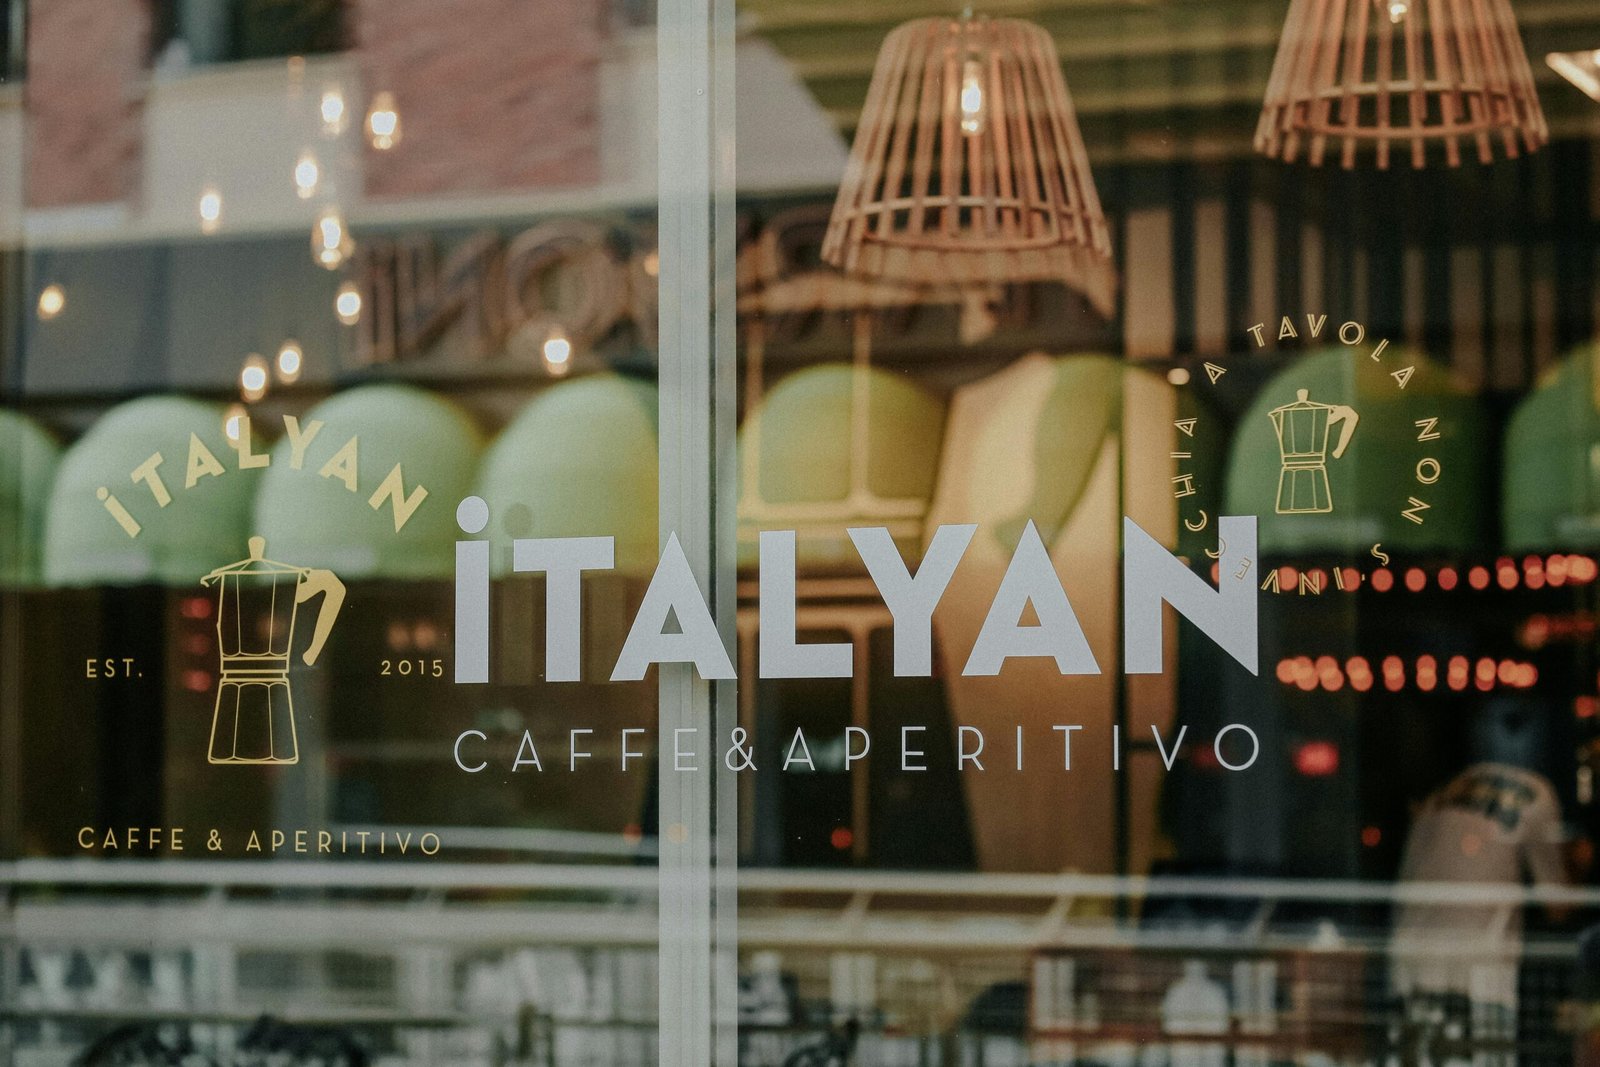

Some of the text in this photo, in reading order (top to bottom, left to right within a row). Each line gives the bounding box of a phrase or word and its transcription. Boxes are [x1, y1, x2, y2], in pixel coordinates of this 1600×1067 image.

[1203, 361, 1227, 384] A
[1247, 313, 1415, 389] TAVOLA
[1401, 417, 1441, 525] NON
[86, 657, 444, 678] EST. 2015
[78, 826, 441, 855] CAFFE & APERITIVO
